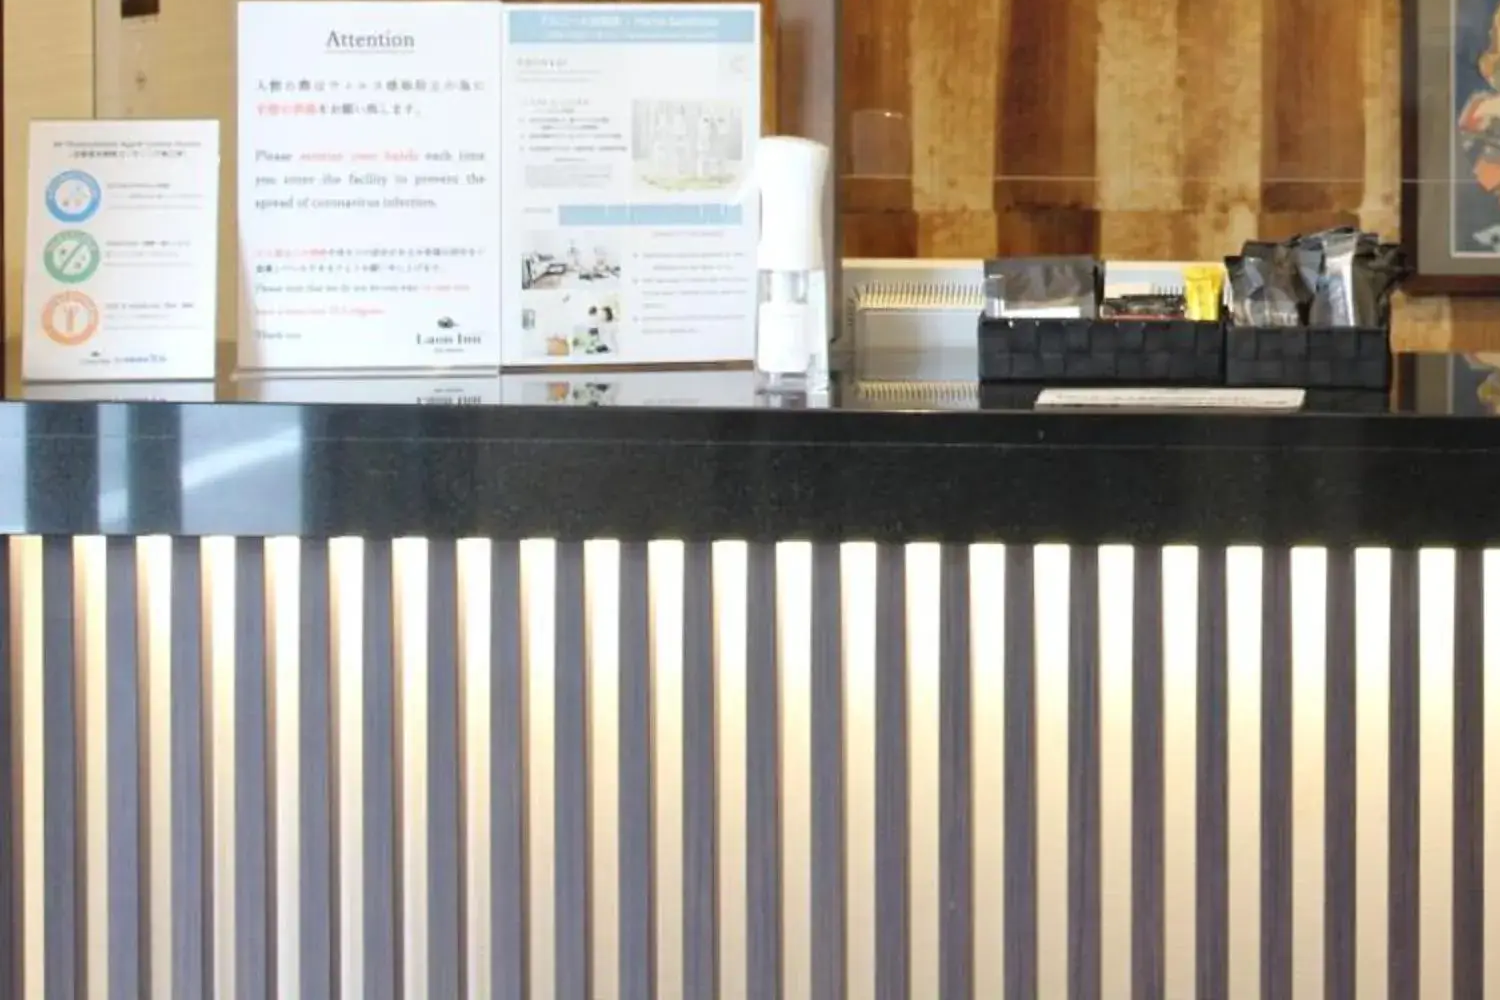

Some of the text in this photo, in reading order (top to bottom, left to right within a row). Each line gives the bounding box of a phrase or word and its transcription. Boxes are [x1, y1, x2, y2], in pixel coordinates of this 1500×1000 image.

[326, 29, 415, 50] Attention
[255, 149, 293, 162] Please
[384, 148, 419, 162] hands
[425, 149, 452, 162] each
[459, 149, 486, 162] time
[255, 172, 487, 188] you enter the facility to prevent the
[255, 196, 438, 210] spread of coronavirus infection.
